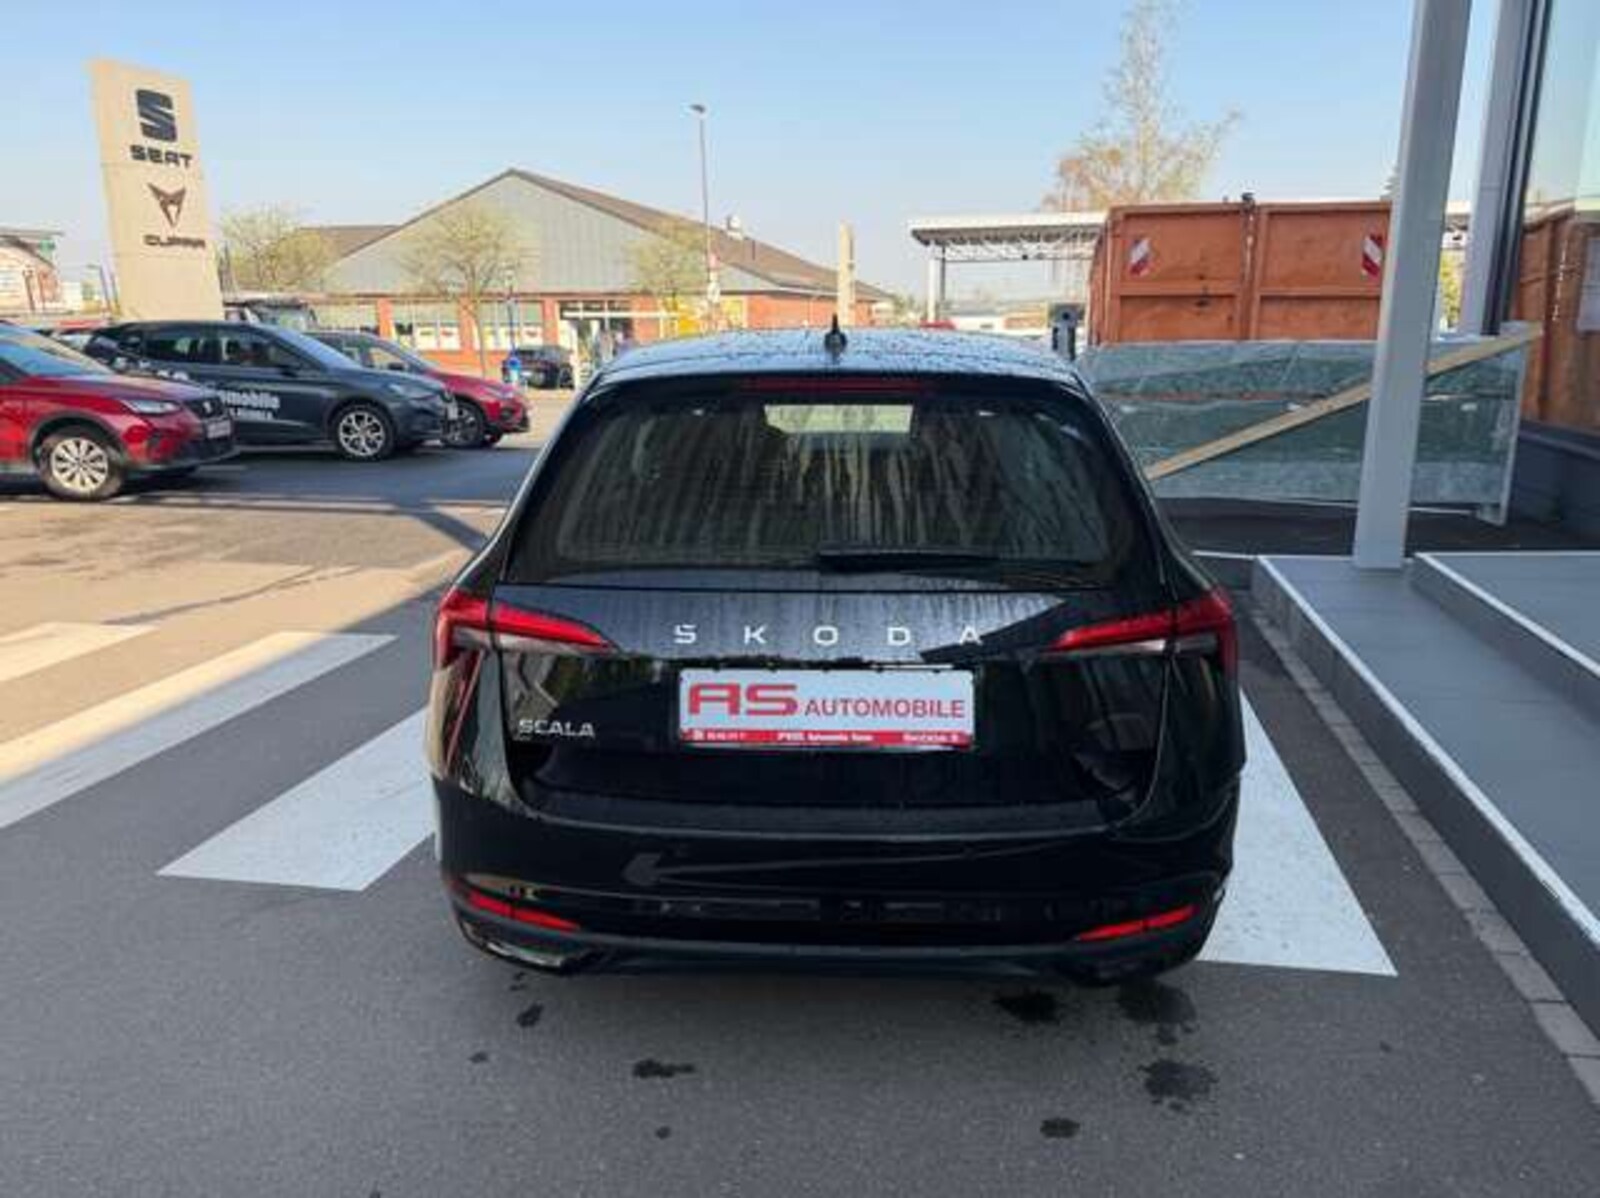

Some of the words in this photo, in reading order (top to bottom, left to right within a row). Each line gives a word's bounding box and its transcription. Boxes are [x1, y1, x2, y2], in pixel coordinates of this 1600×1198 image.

[130, 144, 193, 168] SEAT
[674, 625, 982, 645] SKODA
[688, 682, 798, 715] AS
[804, 698, 966, 718] AUTOMOBILE
[519, 719, 595, 737] SCALA
